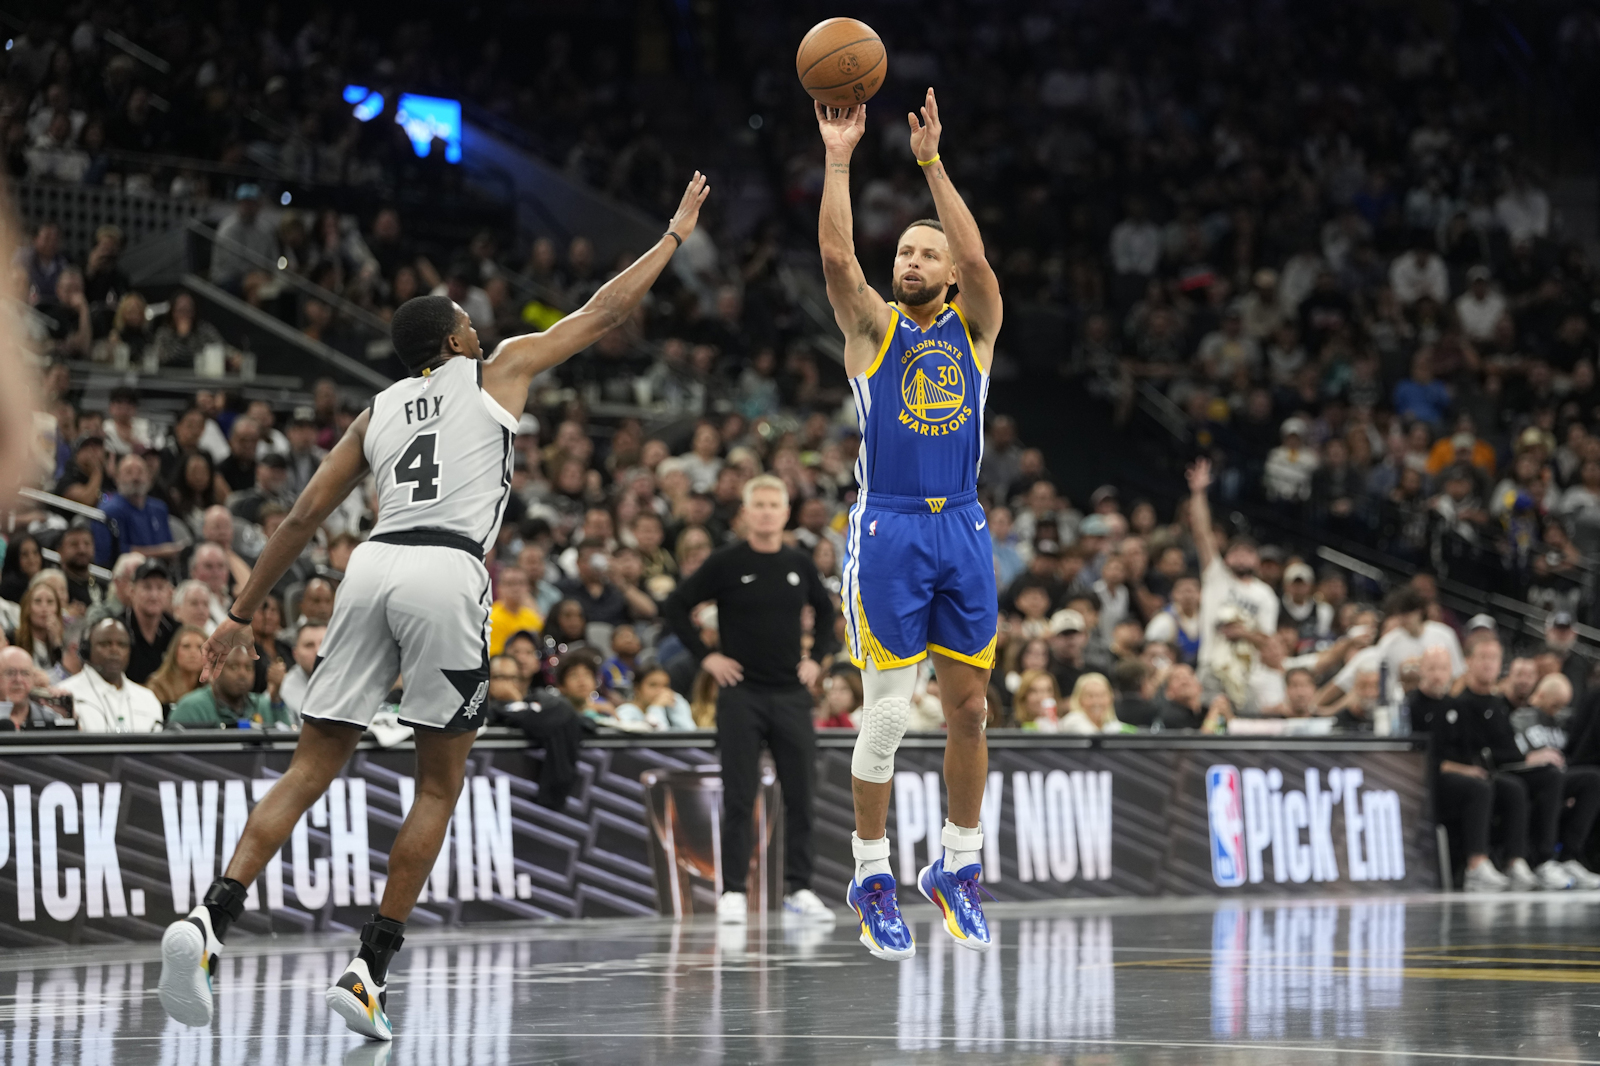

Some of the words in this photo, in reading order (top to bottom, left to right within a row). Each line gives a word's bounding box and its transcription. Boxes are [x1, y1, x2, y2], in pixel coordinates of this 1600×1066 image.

[901, 339, 936, 364] GOLDEN
[938, 340, 963, 360] STATE
[937, 365, 958, 387] 30
[404, 395, 444, 425] FOX
[898, 405, 972, 436] WARRIORS
[391, 430, 442, 505] 4
[894, 770, 1004, 885] PLY
[1012, 769, 1113, 883] NOW
[0, 781, 146, 922] ICK.
